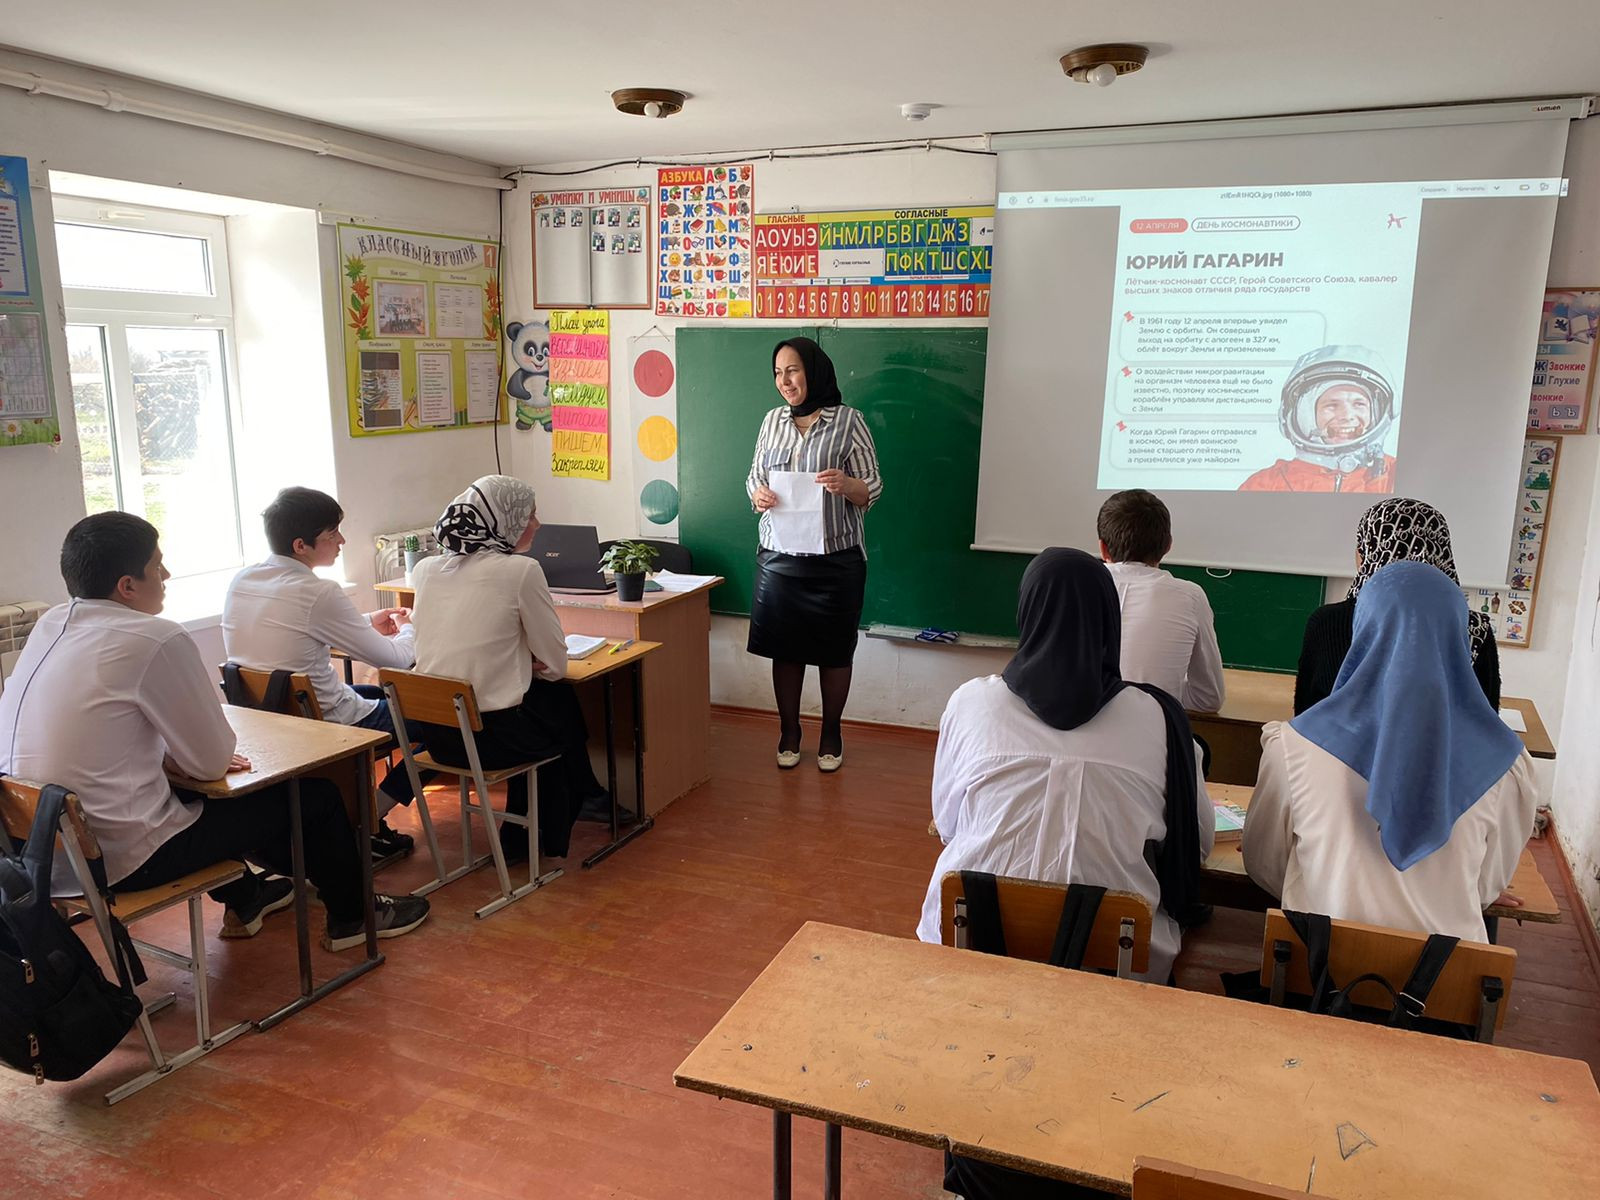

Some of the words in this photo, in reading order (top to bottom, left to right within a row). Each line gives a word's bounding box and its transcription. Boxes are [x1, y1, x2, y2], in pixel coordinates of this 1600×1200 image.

[660, 171, 703, 184] АЗБУКА
[706, 169, 714, 183] А
[729, 169, 737, 182] Б
[550, 192, 584, 205] УМНИКИ
[588, 192, 594, 204] И
[599, 190, 635, 203] УМНИЦЫ
[894, 208, 948, 219] СОГЛАСНЫЕ
[767, 214, 805, 224] ГЛАСНЫЕ
[1196, 221, 1219, 230] ДЕНЬ
[1221, 220, 1293, 229] КОСМОНАВТИКИ
[1126, 251, 1187, 270] ЮРИЙ
[1193, 252, 1284, 269] ГАГАРИН
[1125, 278, 1207, 286] Лётчик-космонавт
[1210, 276, 1237, 286] СССР,
[1239, 276, 1266, 285] Герой
[1269, 275, 1321, 284] Советского
[1324, 275, 1356, 284] Союза,
[1359, 275, 1398, 284] кавалер
[1125, 287, 1159, 295] высших
[1162, 287, 1193, 295] знаков
[1195, 286, 1232, 294] отличия
[1234, 286, 1256, 295] ряда
[1258, 285, 1310, 295] государств
[757, 293, 762, 313] 0
[768, 293, 772, 313] 1
[777, 293, 783, 313] 2
[788, 293, 795, 313] 3
[798, 293, 805, 313] 4
[809, 292, 816, 313] 5
[820, 292, 826, 313] 6
[832, 292, 838, 313] 7
[842, 292, 849, 313] 8
[853, 291, 860, 313] 9
[864, 292, 876, 313] 10
[880, 291, 891, 313] 11
[895, 291, 908, 313] 12
[911, 291, 924, 312] 13
[927, 290, 940, 312] 14
[944, 290, 956, 312] 15
[960, 290, 973, 311] 16
[1140, 317, 1145, 325] В
[1147, 317, 1163, 325] 1961
[1164, 317, 1182, 325] году
[1184, 317, 1192, 325] 12
[1193, 317, 1221, 325] апреля
[1223, 317, 1257, 325] впервые
[1259, 317, 1287, 325] увидел
[1138, 326, 1164, 334] Землю
[1166, 326, 1171, 334] с
[1206, 326, 1218, 334] Он
[1220, 326, 1260, 334] совершил
[1138, 336, 1162, 344] выход
[1164, 336, 1173, 344] на
[1175, 336, 1204, 344] орбиту
[1205, 336, 1209, 344] с
[1246, 336, 1251, 344] в
[1252, 336, 1267, 344] 327
[1269, 336, 1280, 344] км,
[1549, 361, 1586, 371] Звонкие
[1136, 368, 1143, 376] О
[1144, 368, 1193, 376] воздействии
[1195, 368, 1265, 376] микрогравитации
[1134, 378, 1144, 386] на
[1146, 378, 1182, 386] организм
[1184, 378, 1220, 386] человека
[1222, 378, 1239, 386] ещё
[1241, 378, 1250, 386] не
[1252, 378, 1273, 386] было
[1548, 375, 1580, 387] Глухие
[1134, 387, 1171, 395] известно,
[1172, 387, 1205, 395] поэтому
[1207, 387, 1259, 395] космическим
[1130, 428, 1153, 436] Когда
[1154, 428, 1177, 436] Юрий
[1179, 428, 1209, 436] Гагарин
[1210, 428, 1257, 436] отправился
[556, 431, 602, 453] ПИШЕМ
[1128, 457, 1132, 465] а
[1134, 457, 1185, 465] приземлился
[1187, 457, 1202, 465] уже
[1204, 457, 1240, 465] майором
